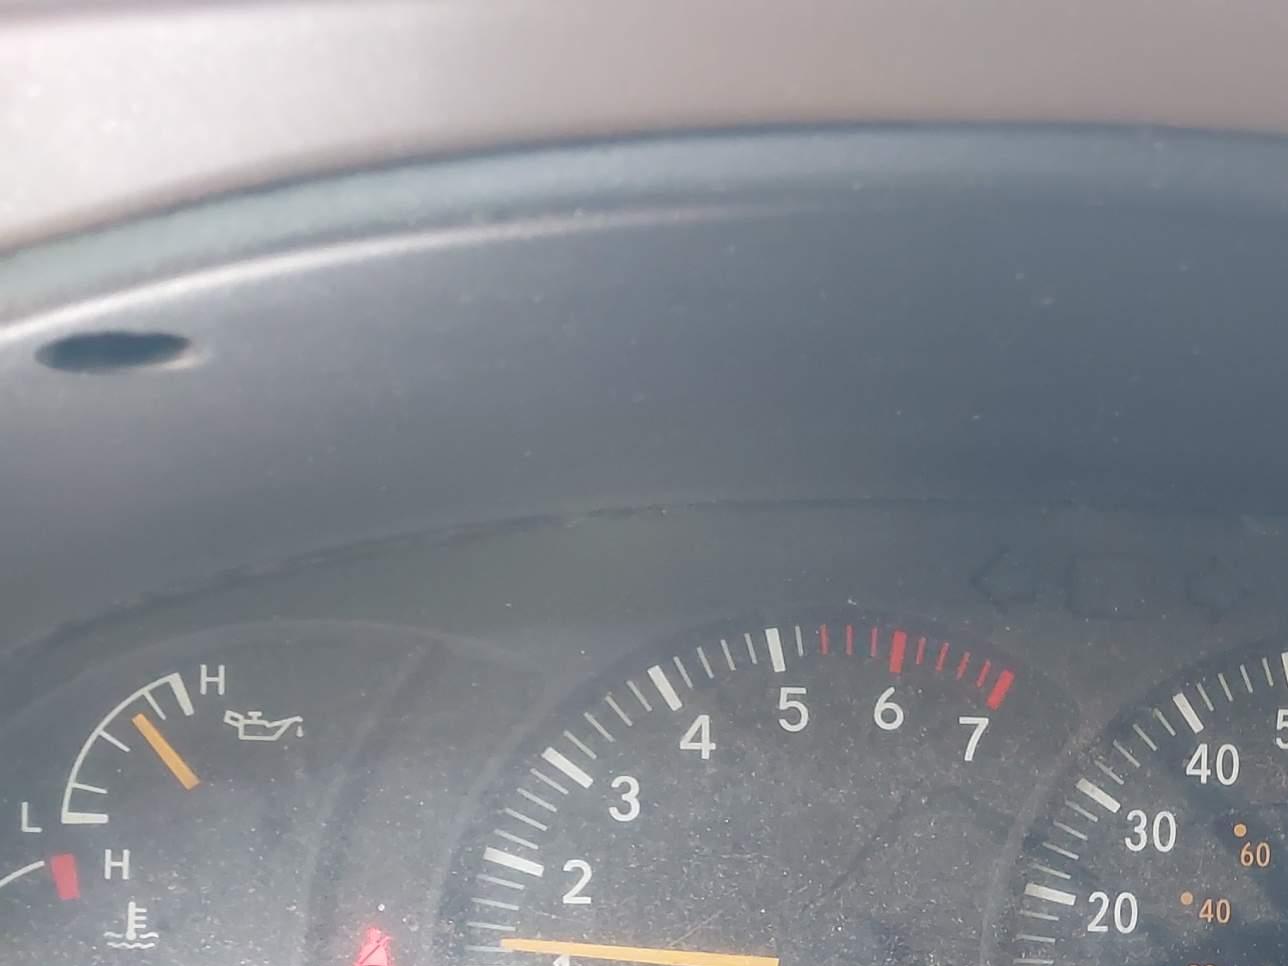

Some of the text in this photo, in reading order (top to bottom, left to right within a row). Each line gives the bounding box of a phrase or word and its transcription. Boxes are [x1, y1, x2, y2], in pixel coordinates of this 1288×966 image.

[200, 664, 225, 695] H
[778, 687, 809, 731] 5
[873, 687, 904, 730] 6
[680, 715, 716, 759] 4
[958, 716, 989, 761] 7
[1185, 743, 1241, 786] 40
[22, 802, 42, 832] L
[608, 776, 640, 821] 3
[1124, 810, 1178, 853] 30
[105, 849, 130, 880] H
[1240, 842, 1271, 868] 60
[562, 860, 592, 905] 2
[1087, 891, 1138, 935] 20
[1199, 898, 1232, 924] 40
